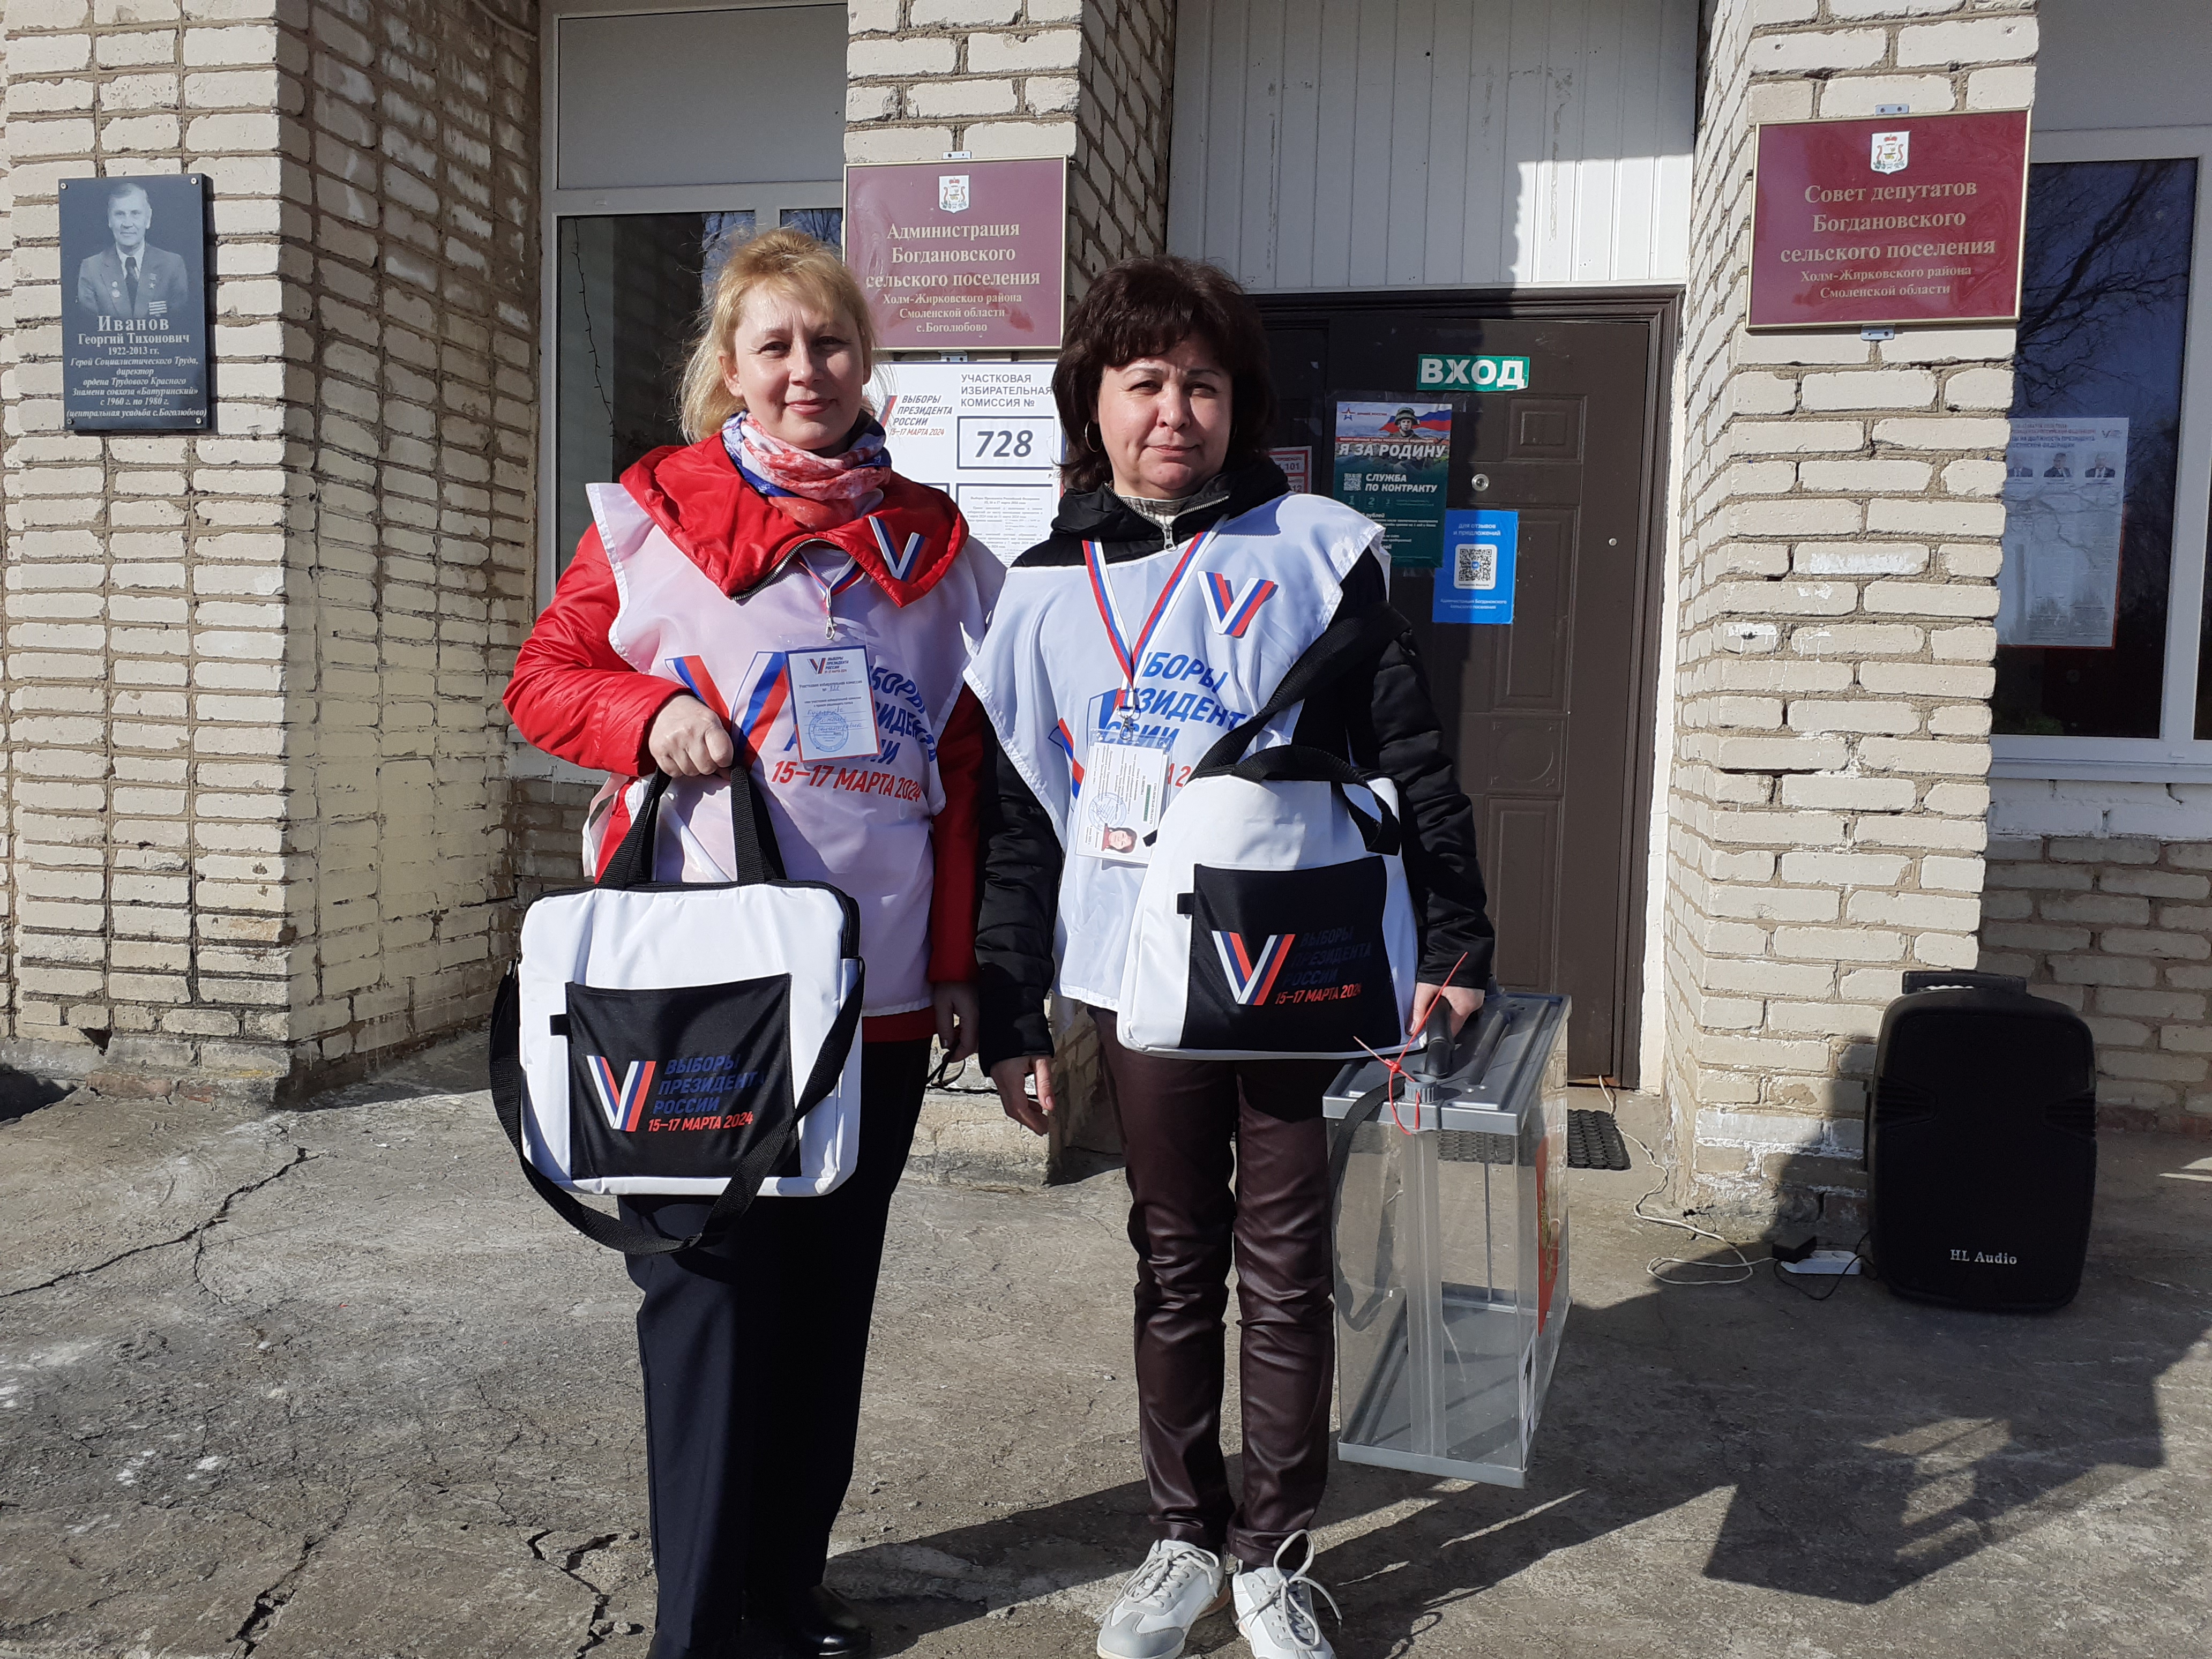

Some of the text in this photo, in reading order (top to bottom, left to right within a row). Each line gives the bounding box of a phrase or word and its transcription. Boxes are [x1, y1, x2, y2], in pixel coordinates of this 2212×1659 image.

[1805, 181, 1977, 203] Совет депутатов
[1812, 212, 1966, 232] Богдановского
[886, 223, 1020, 241] Администрация
[891, 246, 1015, 264] Богдановского
[1780, 239, 1996, 263] сельского поселения
[866, 272, 1041, 288] сельского поселения
[1800, 266, 1972, 282] Холм-Жирковского района
[883, 293, 1022, 304] Холм-Жирковского района
[1820, 284, 1951, 299] Смоленской области
[899, 308, 1005, 318] Смоленской области
[97, 315, 169, 332] Иванов
[916, 323, 988, 333] с.Боголюбово
[78, 333, 190, 346] Георгий Тихонович
[108, 347, 148, 355] 1922-2013
[70, 356, 199, 367] Герой Социалистического Труда,
[116, 368, 154, 377] директор
[960, 374, 1032, 383] УЧАСТКОВАЯ
[1421, 358, 1525, 388] ВХОД
[111, 377, 149, 386] Трудового
[151, 377, 186, 385] Красного
[72, 387, 105, 396] Знамени
[136, 387, 199, 397] «Батуринский»
[960, 386, 1053, 395] ИЗБИРАТЕЛЬНАЯ
[107, 397, 124, 405] 1960
[144, 397, 163, 405] 1980
[901, 395, 942, 403] ВЫБОРЫ
[960, 398, 1035, 407] КОМИССИЯ №
[121, 408, 152, 417] усадьба
[896, 406, 953, 416] ПРЕЗИДЕНТА
[893, 417, 929, 426] РОССИИ
[908, 428, 928, 436] МАРТА
[975, 430, 1034, 458] 728
[1340, 443, 1446, 459] Я ЗА РОДИНУ
[1365, 473, 1407, 482] СЛУЖБА
[1365, 483, 1438, 493] ПО КОНТРАКТУ
[1141, 652, 1228, 694] БОРЫ
[771, 760, 922, 803] 15–17 МАРТА 2024
[1299, 925, 1355, 947] ВЫБОРЫ
[1290, 942, 1372, 968] ПРЕЗИДЕНТА
[1282, 968, 1339, 987] РОССИИ
[1304, 986, 1340, 1003] МАРТА
[664, 1055, 739, 1075] ВЫБОРЫ
[658, 1072, 766, 1096] ПРЕЗИДЕНТА
[653, 1096, 720, 1115] РОССИИ
[648, 1111, 754, 1132] 15–17 МАРТА 2024
[1950, 1249, 2018, 1265] HL Audio
